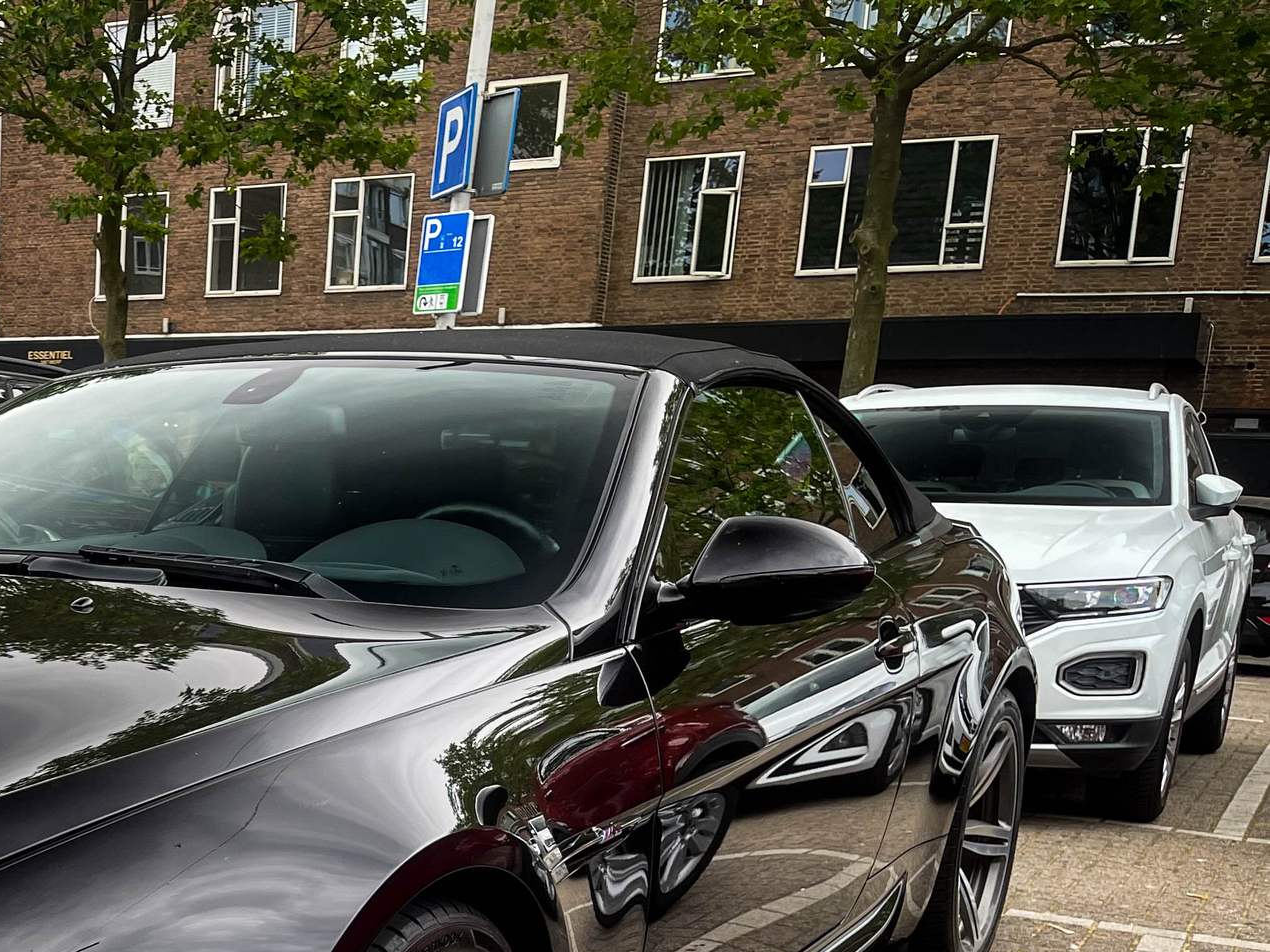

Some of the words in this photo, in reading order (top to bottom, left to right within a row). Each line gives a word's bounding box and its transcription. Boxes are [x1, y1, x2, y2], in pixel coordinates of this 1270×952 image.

[439, 106, 464, 184] P
[424, 218, 443, 251] P
[452, 236, 464, 248] 12
[27, 350, 74, 360] ESSENTIEL
